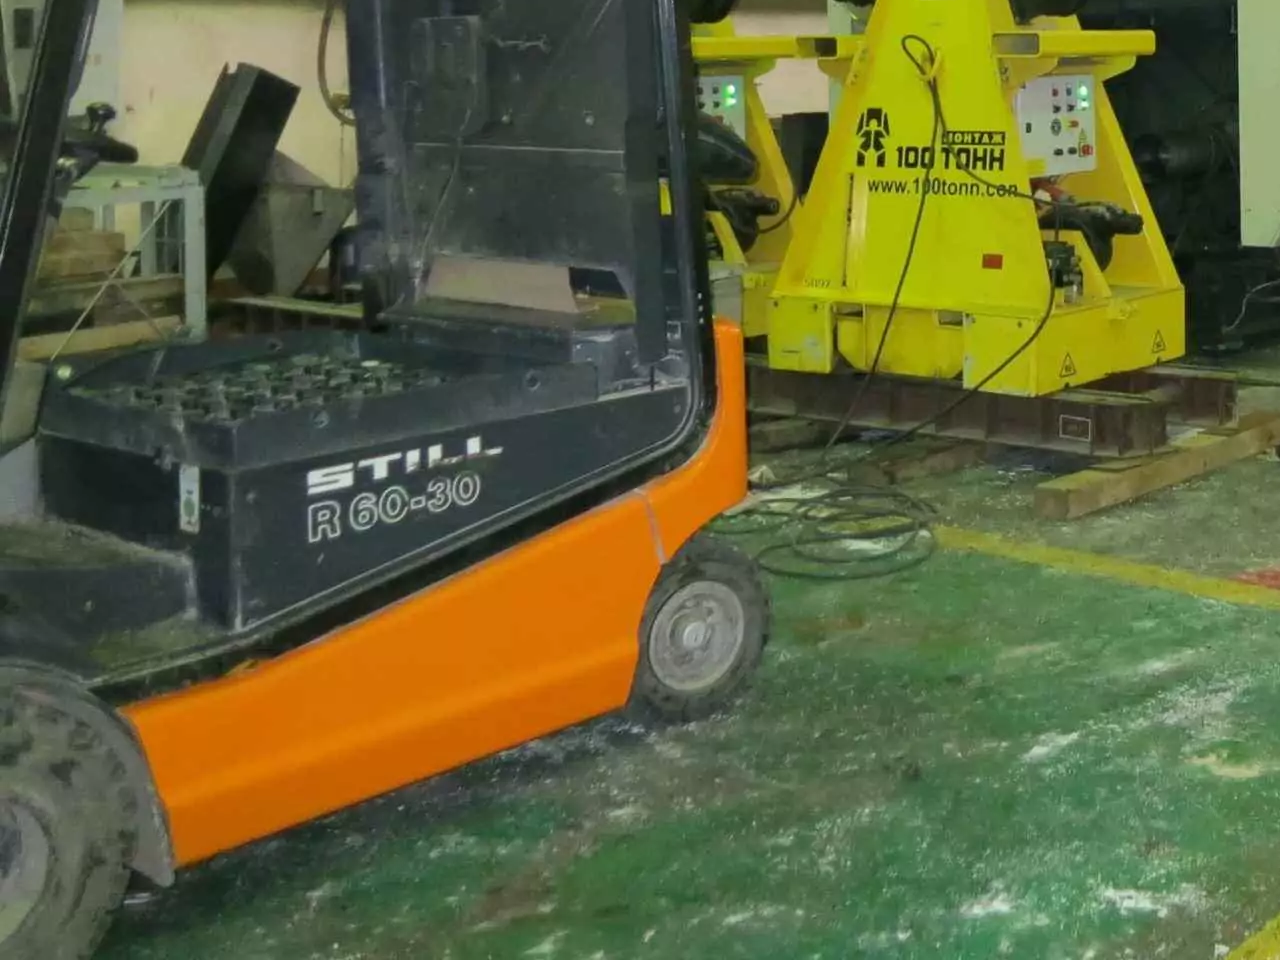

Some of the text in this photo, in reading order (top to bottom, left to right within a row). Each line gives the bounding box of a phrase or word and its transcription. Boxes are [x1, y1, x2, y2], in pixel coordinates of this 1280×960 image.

[896, 146, 1004, 171] 100 ТОНН
[307, 436, 503, 495] STILL
[308, 472, 480, 543] R 60-30
